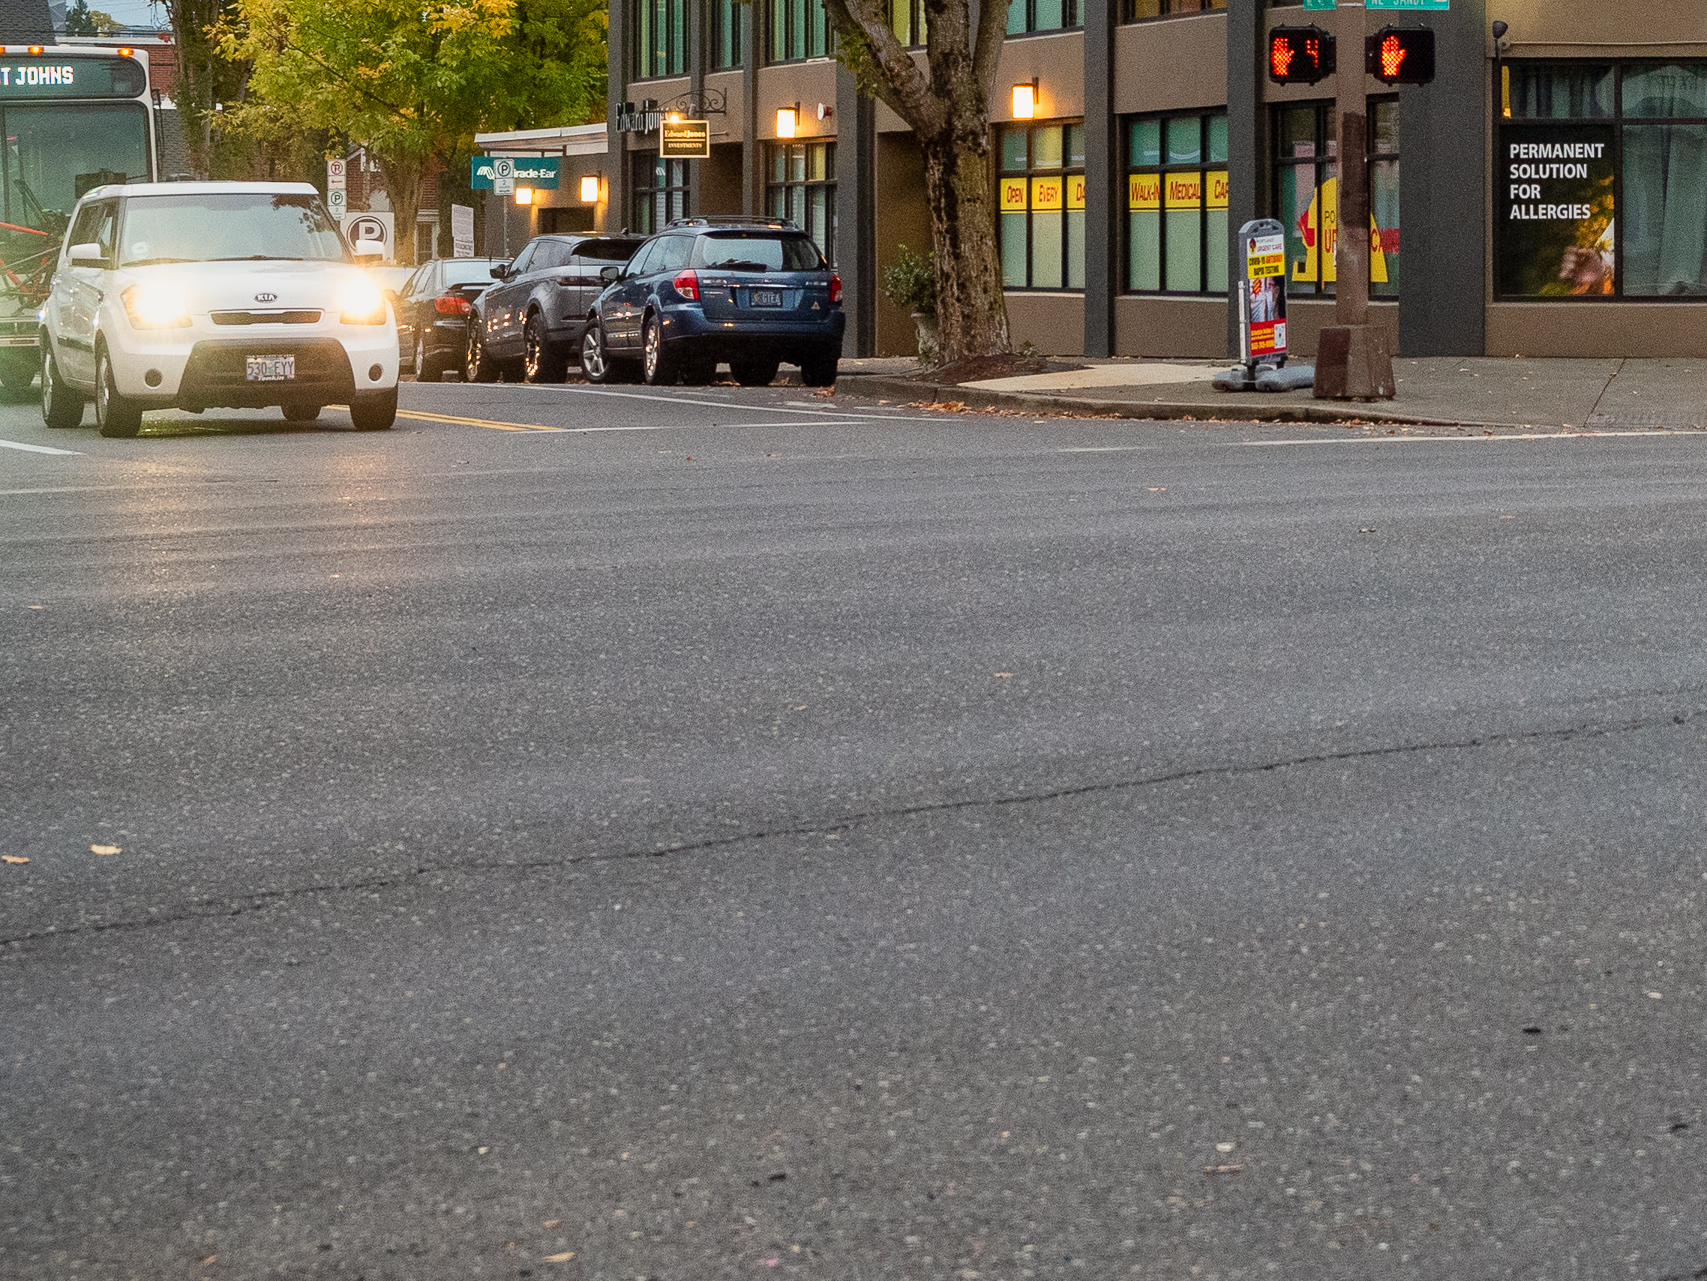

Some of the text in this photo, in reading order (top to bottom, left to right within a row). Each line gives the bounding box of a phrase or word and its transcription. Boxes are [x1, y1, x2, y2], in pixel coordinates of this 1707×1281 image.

[1305, 39, 1319, 68] 4
[14, 65, 74, 86] JOHNS
[664, 129, 706, 138] Edward Jones
[1509, 143, 1605, 159] PERMANENT
[513, 168, 556, 178] iracle-Ear
[1509, 163, 1588, 179] SOLUTION
[1006, 183, 1086, 203] OPEN EVERY DA
[1131, 181, 1160, 201] WALK-IN
[1169, 181, 1200, 200] MEDICAL
[1509, 183, 1541, 199] FOR
[1509, 203, 1591, 220] ALLERGIES
[247, 361, 294, 375] 530 EYY
